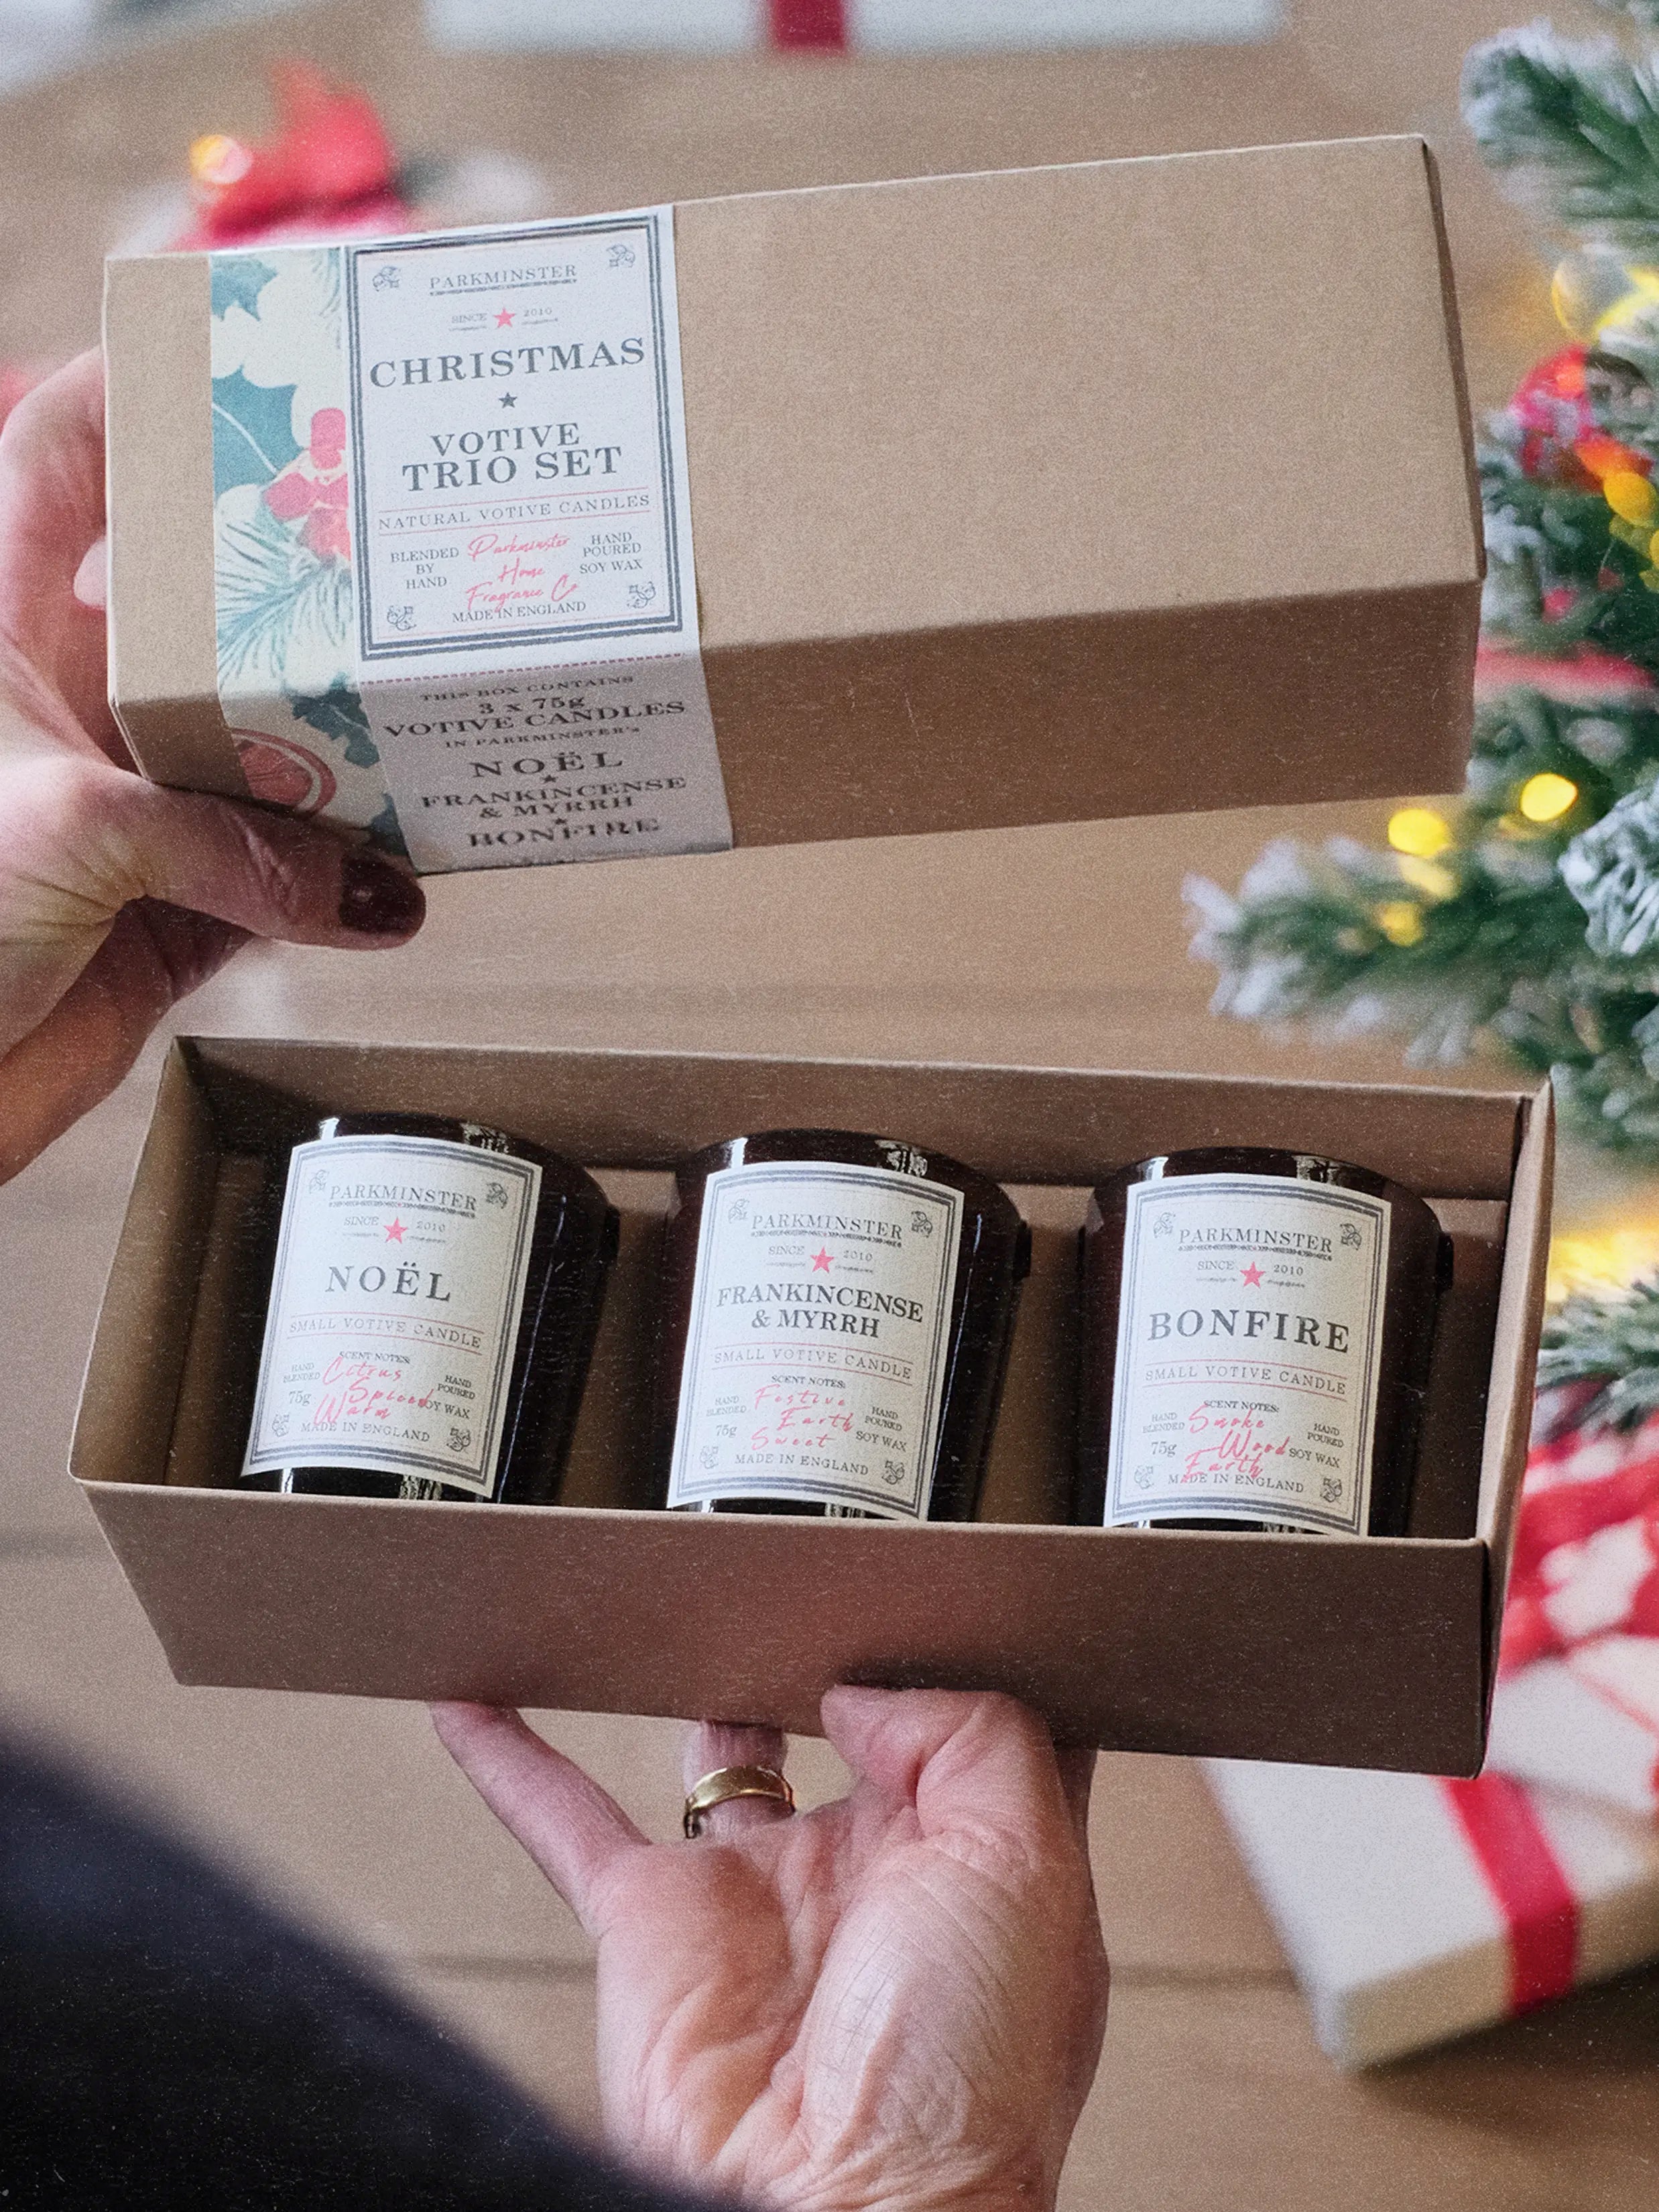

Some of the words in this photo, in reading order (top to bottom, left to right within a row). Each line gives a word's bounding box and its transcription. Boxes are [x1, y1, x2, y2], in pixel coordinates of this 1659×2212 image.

[430, 264, 576, 290] PARKMINSTER
[451, 312, 487, 324] SINCE
[524, 306, 553, 316] 2010
[369, 337, 645, 388] CHRISTMAS
[431, 422, 580, 456] VOTIVE
[402, 456, 517, 492] TRIO
[534, 446, 622, 480] SET
[379, 511, 471, 530] NATURAL
[480, 503, 552, 521] VOTIVE
[558, 493, 650, 514] CANDLES
[591, 531, 633, 545] HAND
[391, 547, 459, 563] BLENDED
[583, 542, 641, 558] POURED
[416, 564, 434, 575] BY
[579, 562, 607, 575] SOY
[611, 558, 643, 572] WAX
[406, 576, 448, 590] HAND
[452, 609, 493, 624] MADE
[497, 607, 515, 619] IN
[517, 601, 587, 619] ENGLAND
[420, 692, 469, 702] THIS
[476, 686, 520, 697] BOX
[527, 676, 635, 693] CONTAINS
[479, 703, 494, 714] 3
[507, 702, 523, 712] x
[533, 695, 587, 711] 75g
[383, 715, 514, 737] VOTIVE
[524, 700, 686, 727] CANDLES
[445, 740, 469, 748] IN
[471, 750, 624, 778] NOËL
[422, 776, 688, 808] FRANKINCENSE
[479, 806, 503, 818] &
[514, 796, 633, 817] MYRRH
[468, 818, 660, 847] BONFIRE
[329, 1184, 477, 1211] PARKMINSTER
[343, 1216, 379, 1227] SINCE
[416, 1220, 446, 1232] 2010
[751, 1213, 902, 1239] PARKMINSTER
[1179, 1227, 1333, 1253] PARKMINSTER
[769, 1245, 805, 1255] SINCE
[843, 1250, 873, 1262] 2010
[1198, 1260, 1235, 1270] SINCE
[1274, 1264, 1304, 1276] 2010
[324, 1262, 450, 1302] NOËL
[715, 1283, 924, 1323] FRANKINCENSE
[290, 1317, 336, 1333] SMALL
[344, 1318, 406, 1334] VOTIVE
[414, 1324, 482, 1349] CANDLE
[751, 1309, 772, 1328] &
[777, 1309, 880, 1338] MYRRH
[1147, 1308, 1351, 1354] BONFIRE
[339, 1351, 373, 1360] SCENT
[714, 1349, 765, 1364] SMALL
[773, 1349, 838, 1363] VOTIVE
[845, 1354, 912, 1379] CANDLE
[292, 1363, 314, 1372] HAND
[322, 1356, 402, 1385] Citrus
[445, 1375, 472, 1388] HAND
[772, 1375, 805, 1384] SCENT
[1146, 1365, 1198, 1381] SMALL
[1205, 1366, 1271, 1380] VOTIVE
[1279, 1371, 1347, 1396] CANDLE
[289, 1391, 312, 1406] 75g
[438, 1382, 475, 1400] POURED
[715, 1396, 739, 1405] HAND
[444, 1405, 471, 1420] WAX
[871, 1407, 898, 1420] HAND
[1204, 1400, 1238, 1409] SCENT
[865, 1416, 902, 1432] POURED
[1152, 1413, 1177, 1422] HAND
[1188, 1404, 1266, 1434] Smoke
[300, 1422, 337, 1432] MADE
[343, 1422, 357, 1432] IN
[362, 1424, 430, 1442] ENGLAND
[715, 1425, 737, 1437] 75g
[1143, 1422, 1186, 1434] BLENDED
[1314, 1422, 1341, 1436] HAND
[856, 1430, 880, 1444] SOY
[881, 1434, 908, 1453] WAX
[1308, 1431, 1344, 1448] POURED
[1152, 1442, 1177, 1457] 75g
[1289, 1448, 1312, 1462] SOY
[1315, 1452, 1341, 1469] WAX
[734, 1454, 774, 1465] MADE
[779, 1454, 795, 1464] IN
[801, 1455, 869, 1476] ENGLAND
[1214, 1474, 1229, 1483] IN
[1235, 1474, 1304, 1493] ENGLAND
